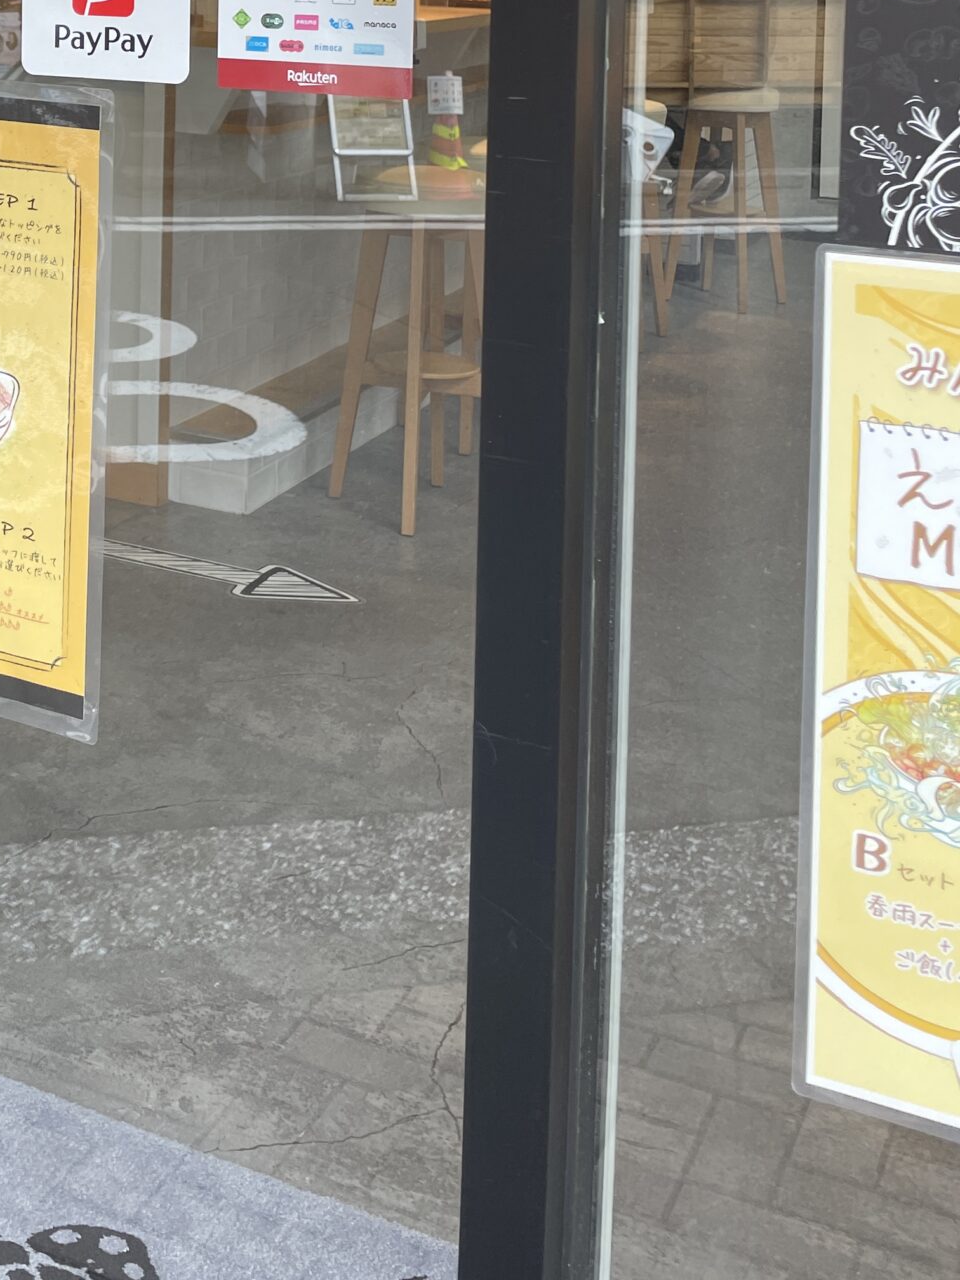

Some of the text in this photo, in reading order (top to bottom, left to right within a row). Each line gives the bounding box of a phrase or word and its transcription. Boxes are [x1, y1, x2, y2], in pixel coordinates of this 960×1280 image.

[54, 24, 153, 58] PayPay
[287, 69, 338, 85] Rakuten
[27, 198, 38, 211] 1
[22, 528, 36, 542] 2
[911, 521, 955, 576] M
[855, 833, 888, 872] B
[897, 864, 955, 890] セット
